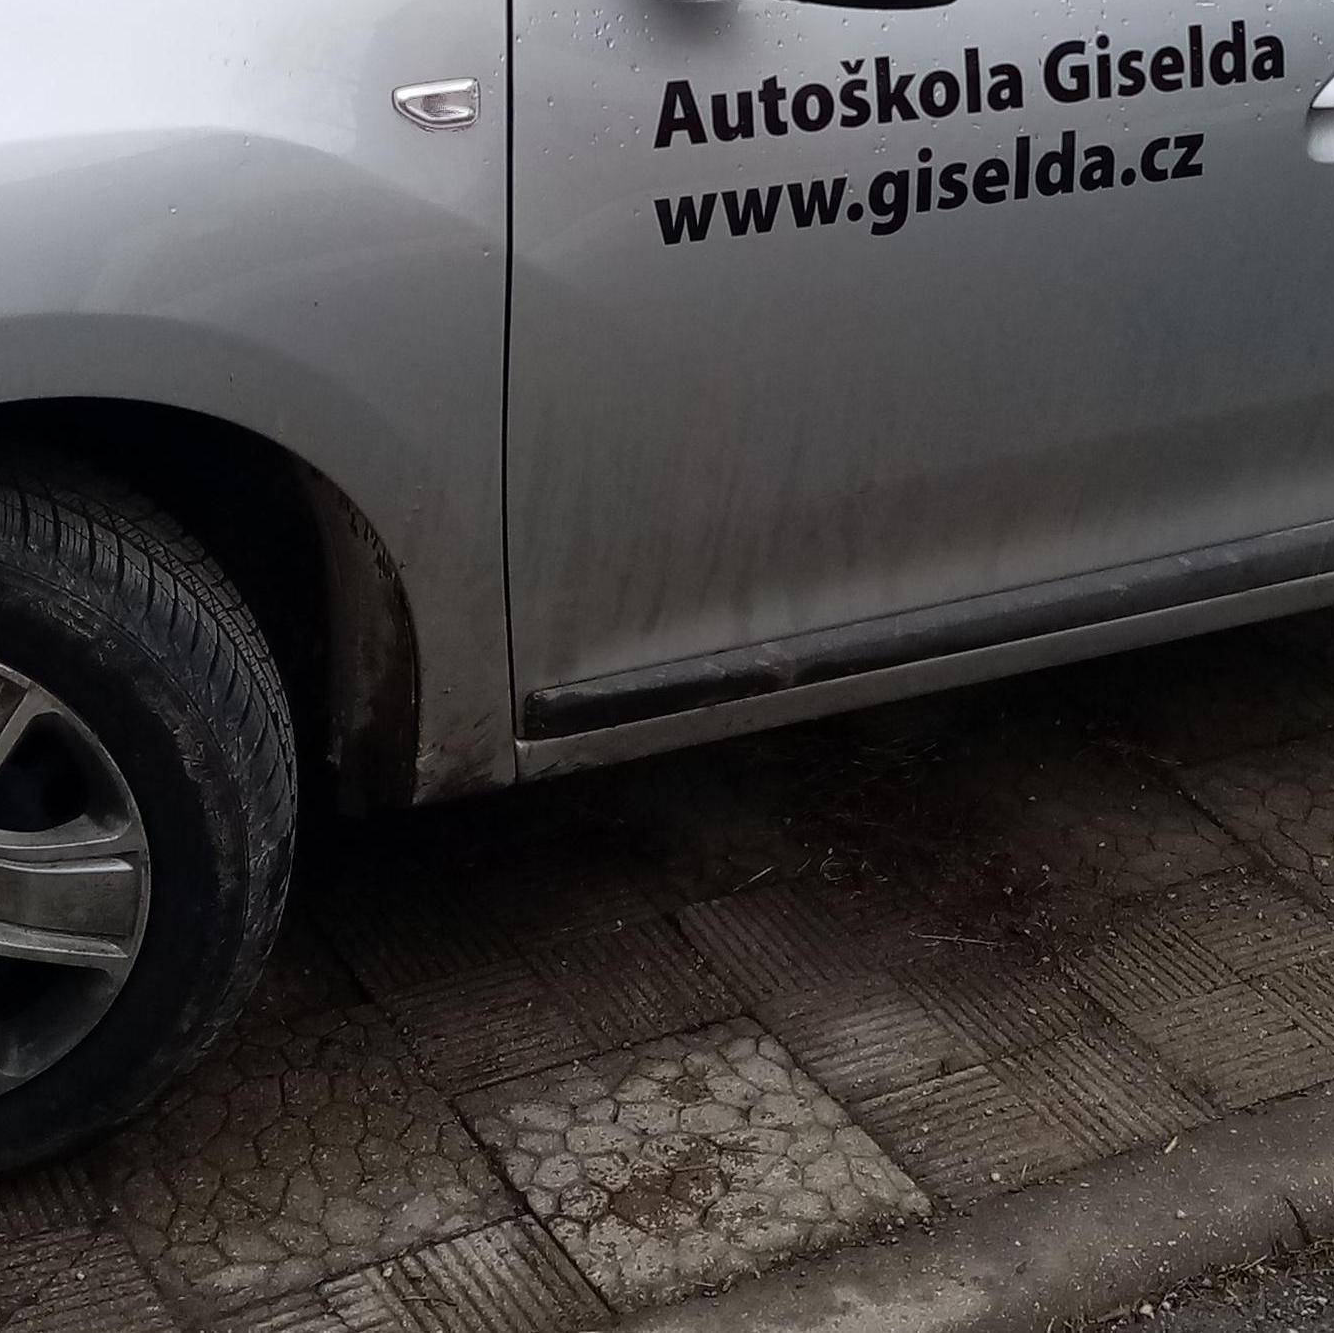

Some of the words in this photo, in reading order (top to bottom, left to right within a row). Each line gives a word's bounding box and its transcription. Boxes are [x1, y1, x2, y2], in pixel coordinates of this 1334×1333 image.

[654, 47, 1023, 148] Autoškola
[1044, 20, 1285, 103] Giselda
[654, 131, 1204, 245] www.giselda.cz
